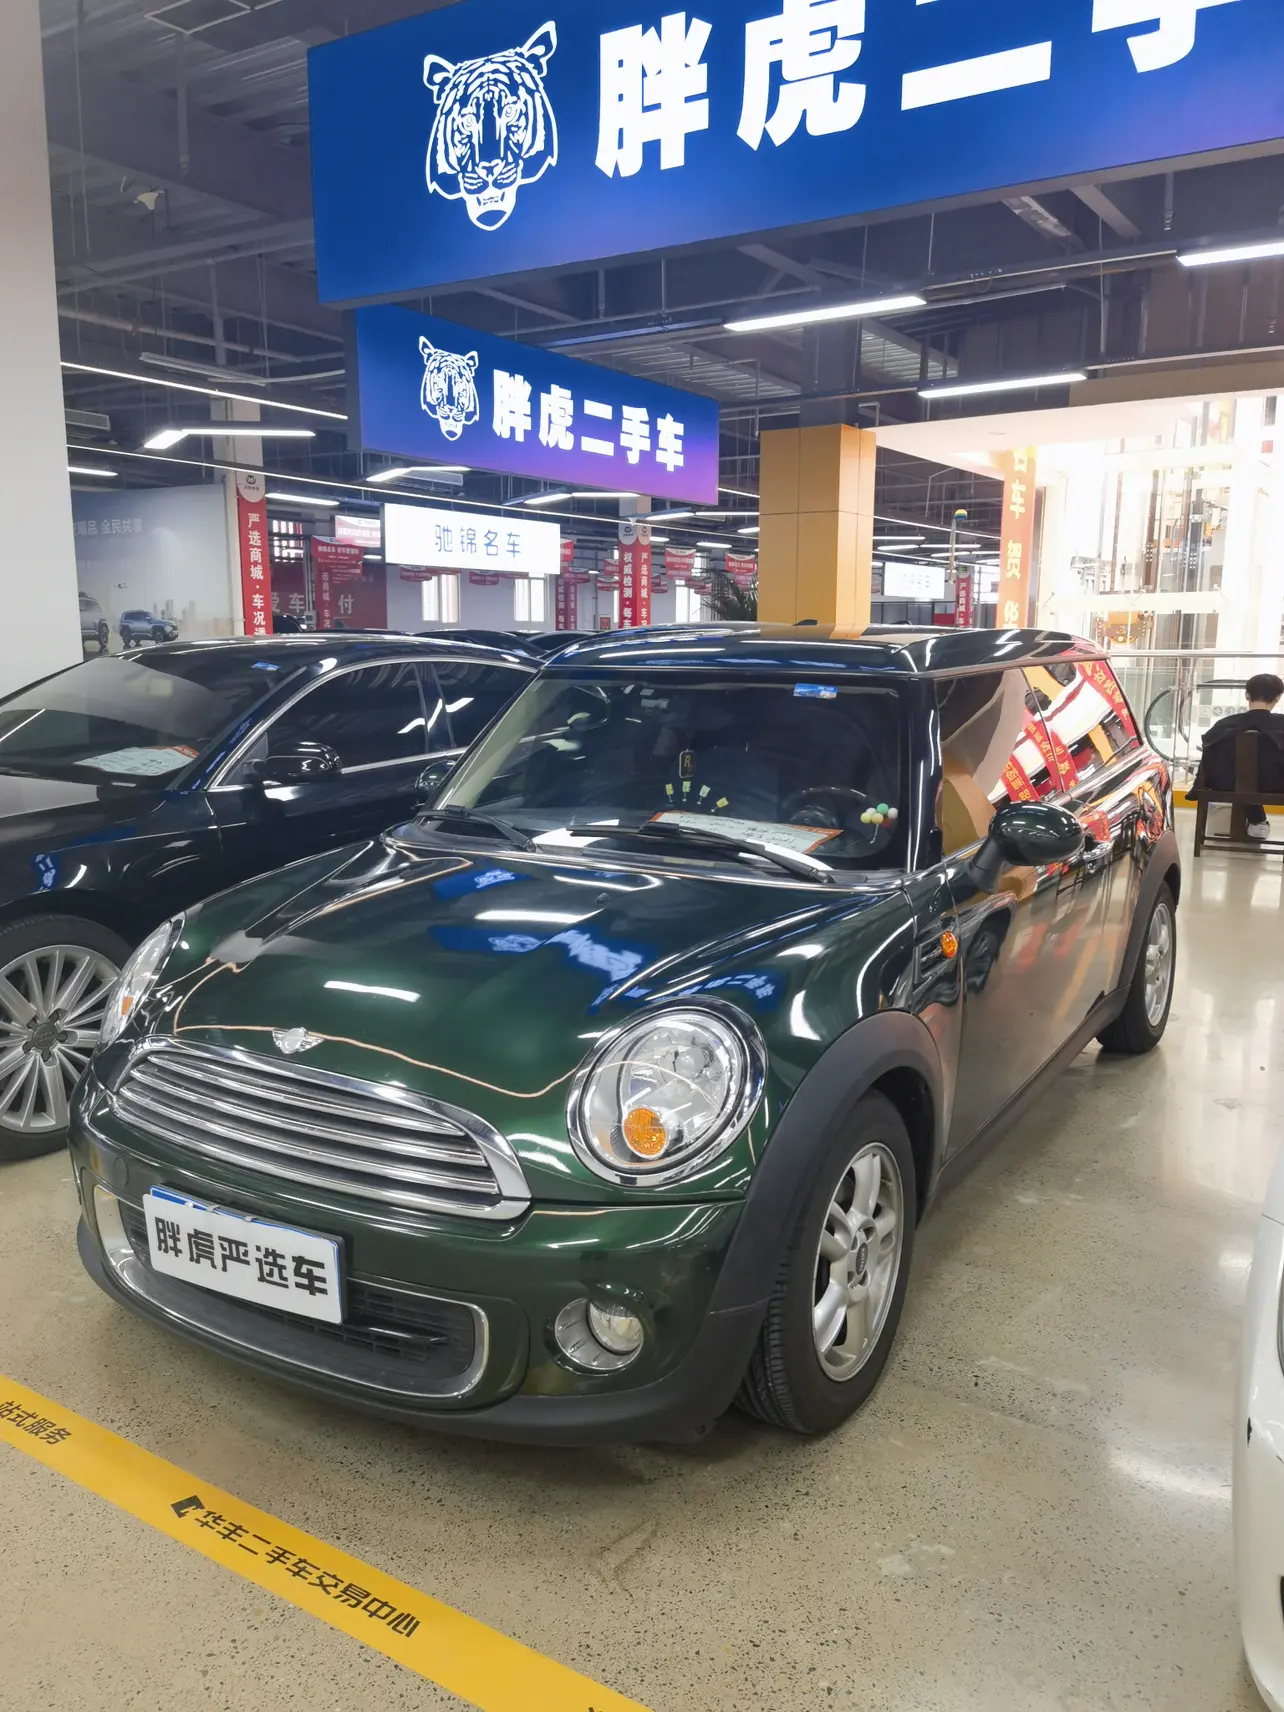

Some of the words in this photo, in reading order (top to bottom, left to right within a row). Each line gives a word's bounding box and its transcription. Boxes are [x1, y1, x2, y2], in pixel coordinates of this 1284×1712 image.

[492, 369, 685, 472] 胖虎二手车
[434, 523, 522, 558] 驰锦名车
[154, 1216, 328, 1296] 胖虎严选车
[193, 1509, 421, 1638] 华丰二手车交易中心
